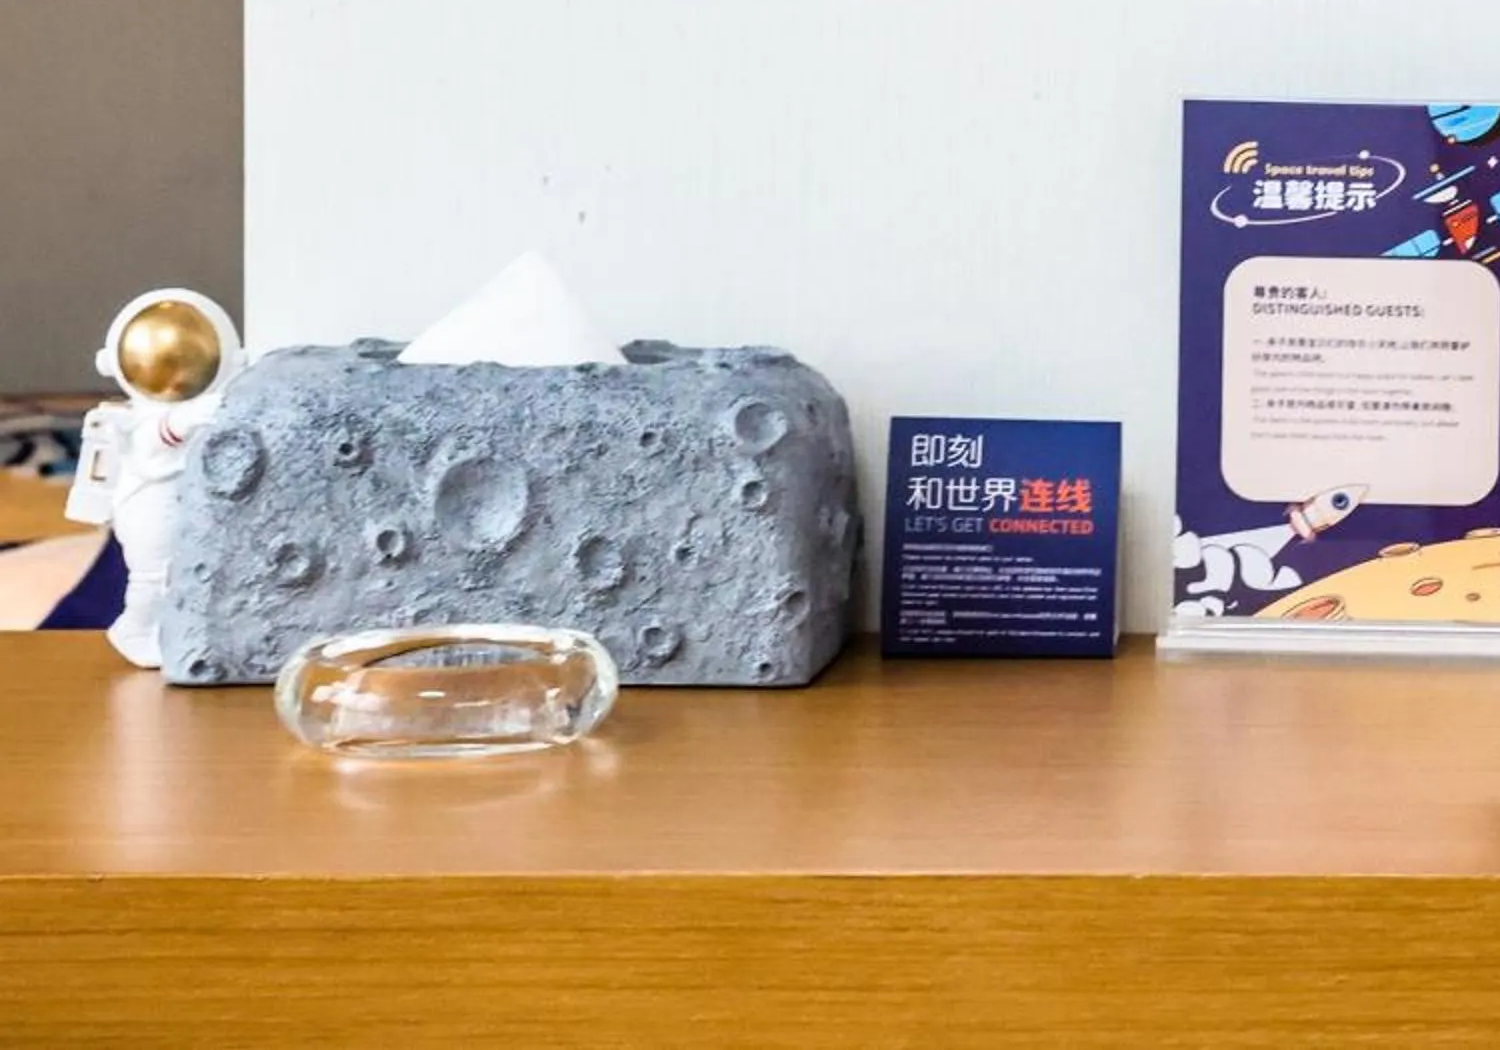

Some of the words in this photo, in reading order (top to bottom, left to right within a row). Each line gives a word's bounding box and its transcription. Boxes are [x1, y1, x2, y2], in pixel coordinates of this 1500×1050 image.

[1264, 163, 1303, 177] Space
[1306, 164, 1347, 176] travel
[1349, 165, 1375, 179] tips
[1252, 179, 1378, 211] 温馨提示
[1252, 303, 1363, 317] DISTINGUISHED
[1364, 304, 1426, 318] GUESTS:
[911, 434, 984, 468] 即刻
[906, 476, 1093, 513] 和世界连线
[904, 516, 948, 533] LET'S
[951, 517, 983, 533] GET
[989, 518, 1094, 535] CONNECTED
